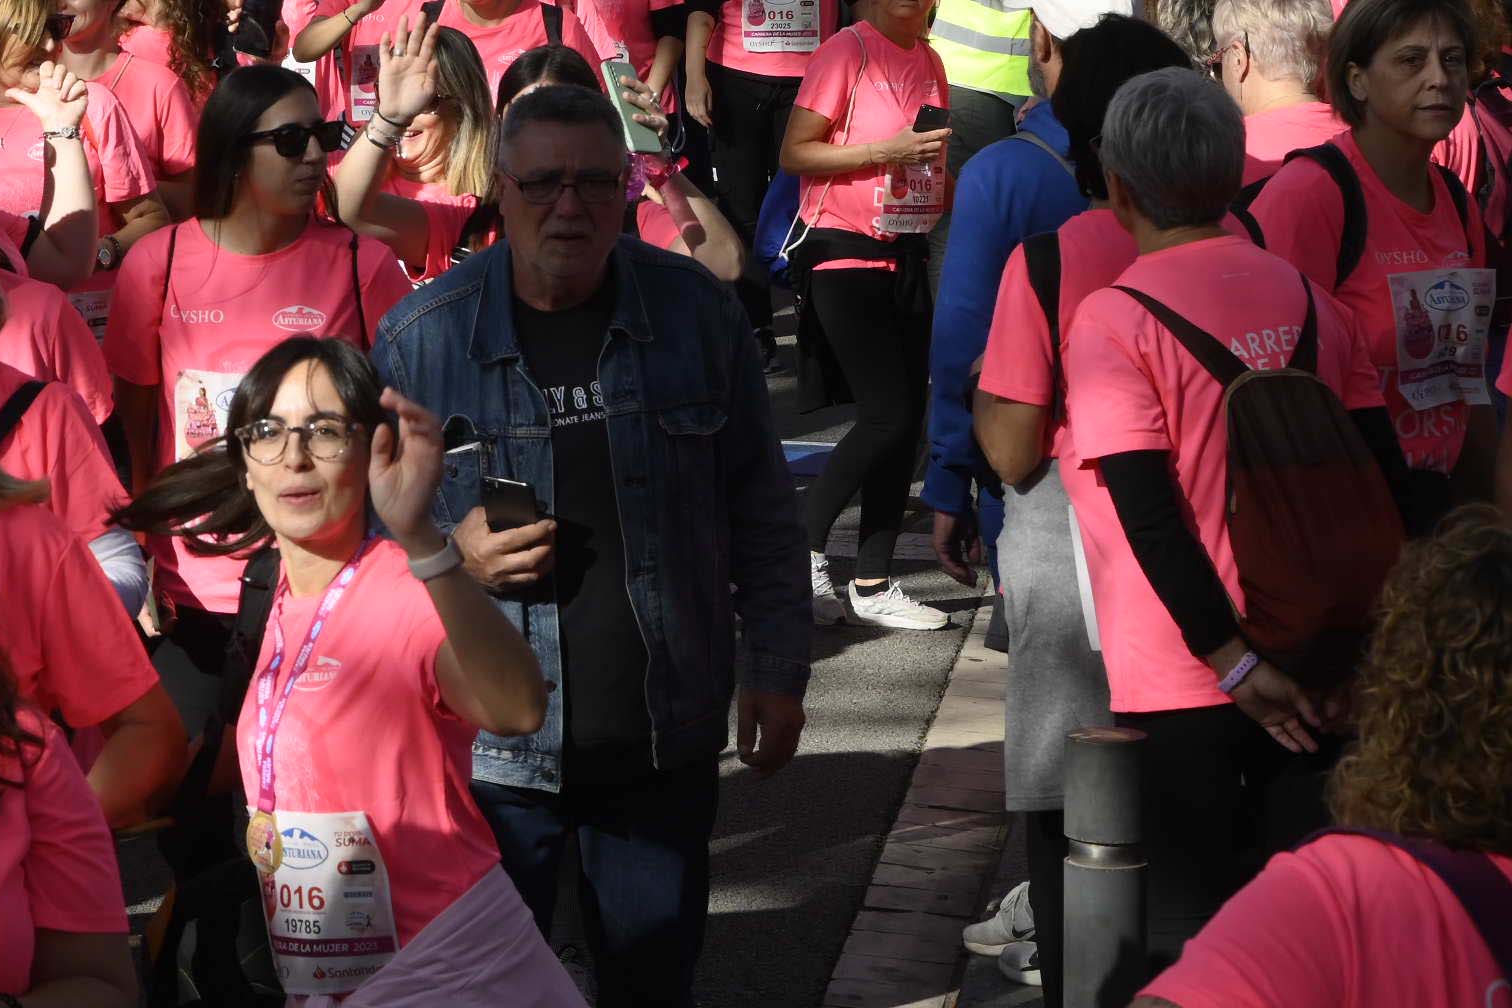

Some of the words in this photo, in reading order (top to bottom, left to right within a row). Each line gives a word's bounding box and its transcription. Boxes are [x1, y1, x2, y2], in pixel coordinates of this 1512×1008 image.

[768, 10, 794, 20] 016
[909, 179, 932, 191] 016
[279, 883, 326, 910] 016
[285, 918, 321, 934] 19785
[312, 943, 349, 953] MUJER
